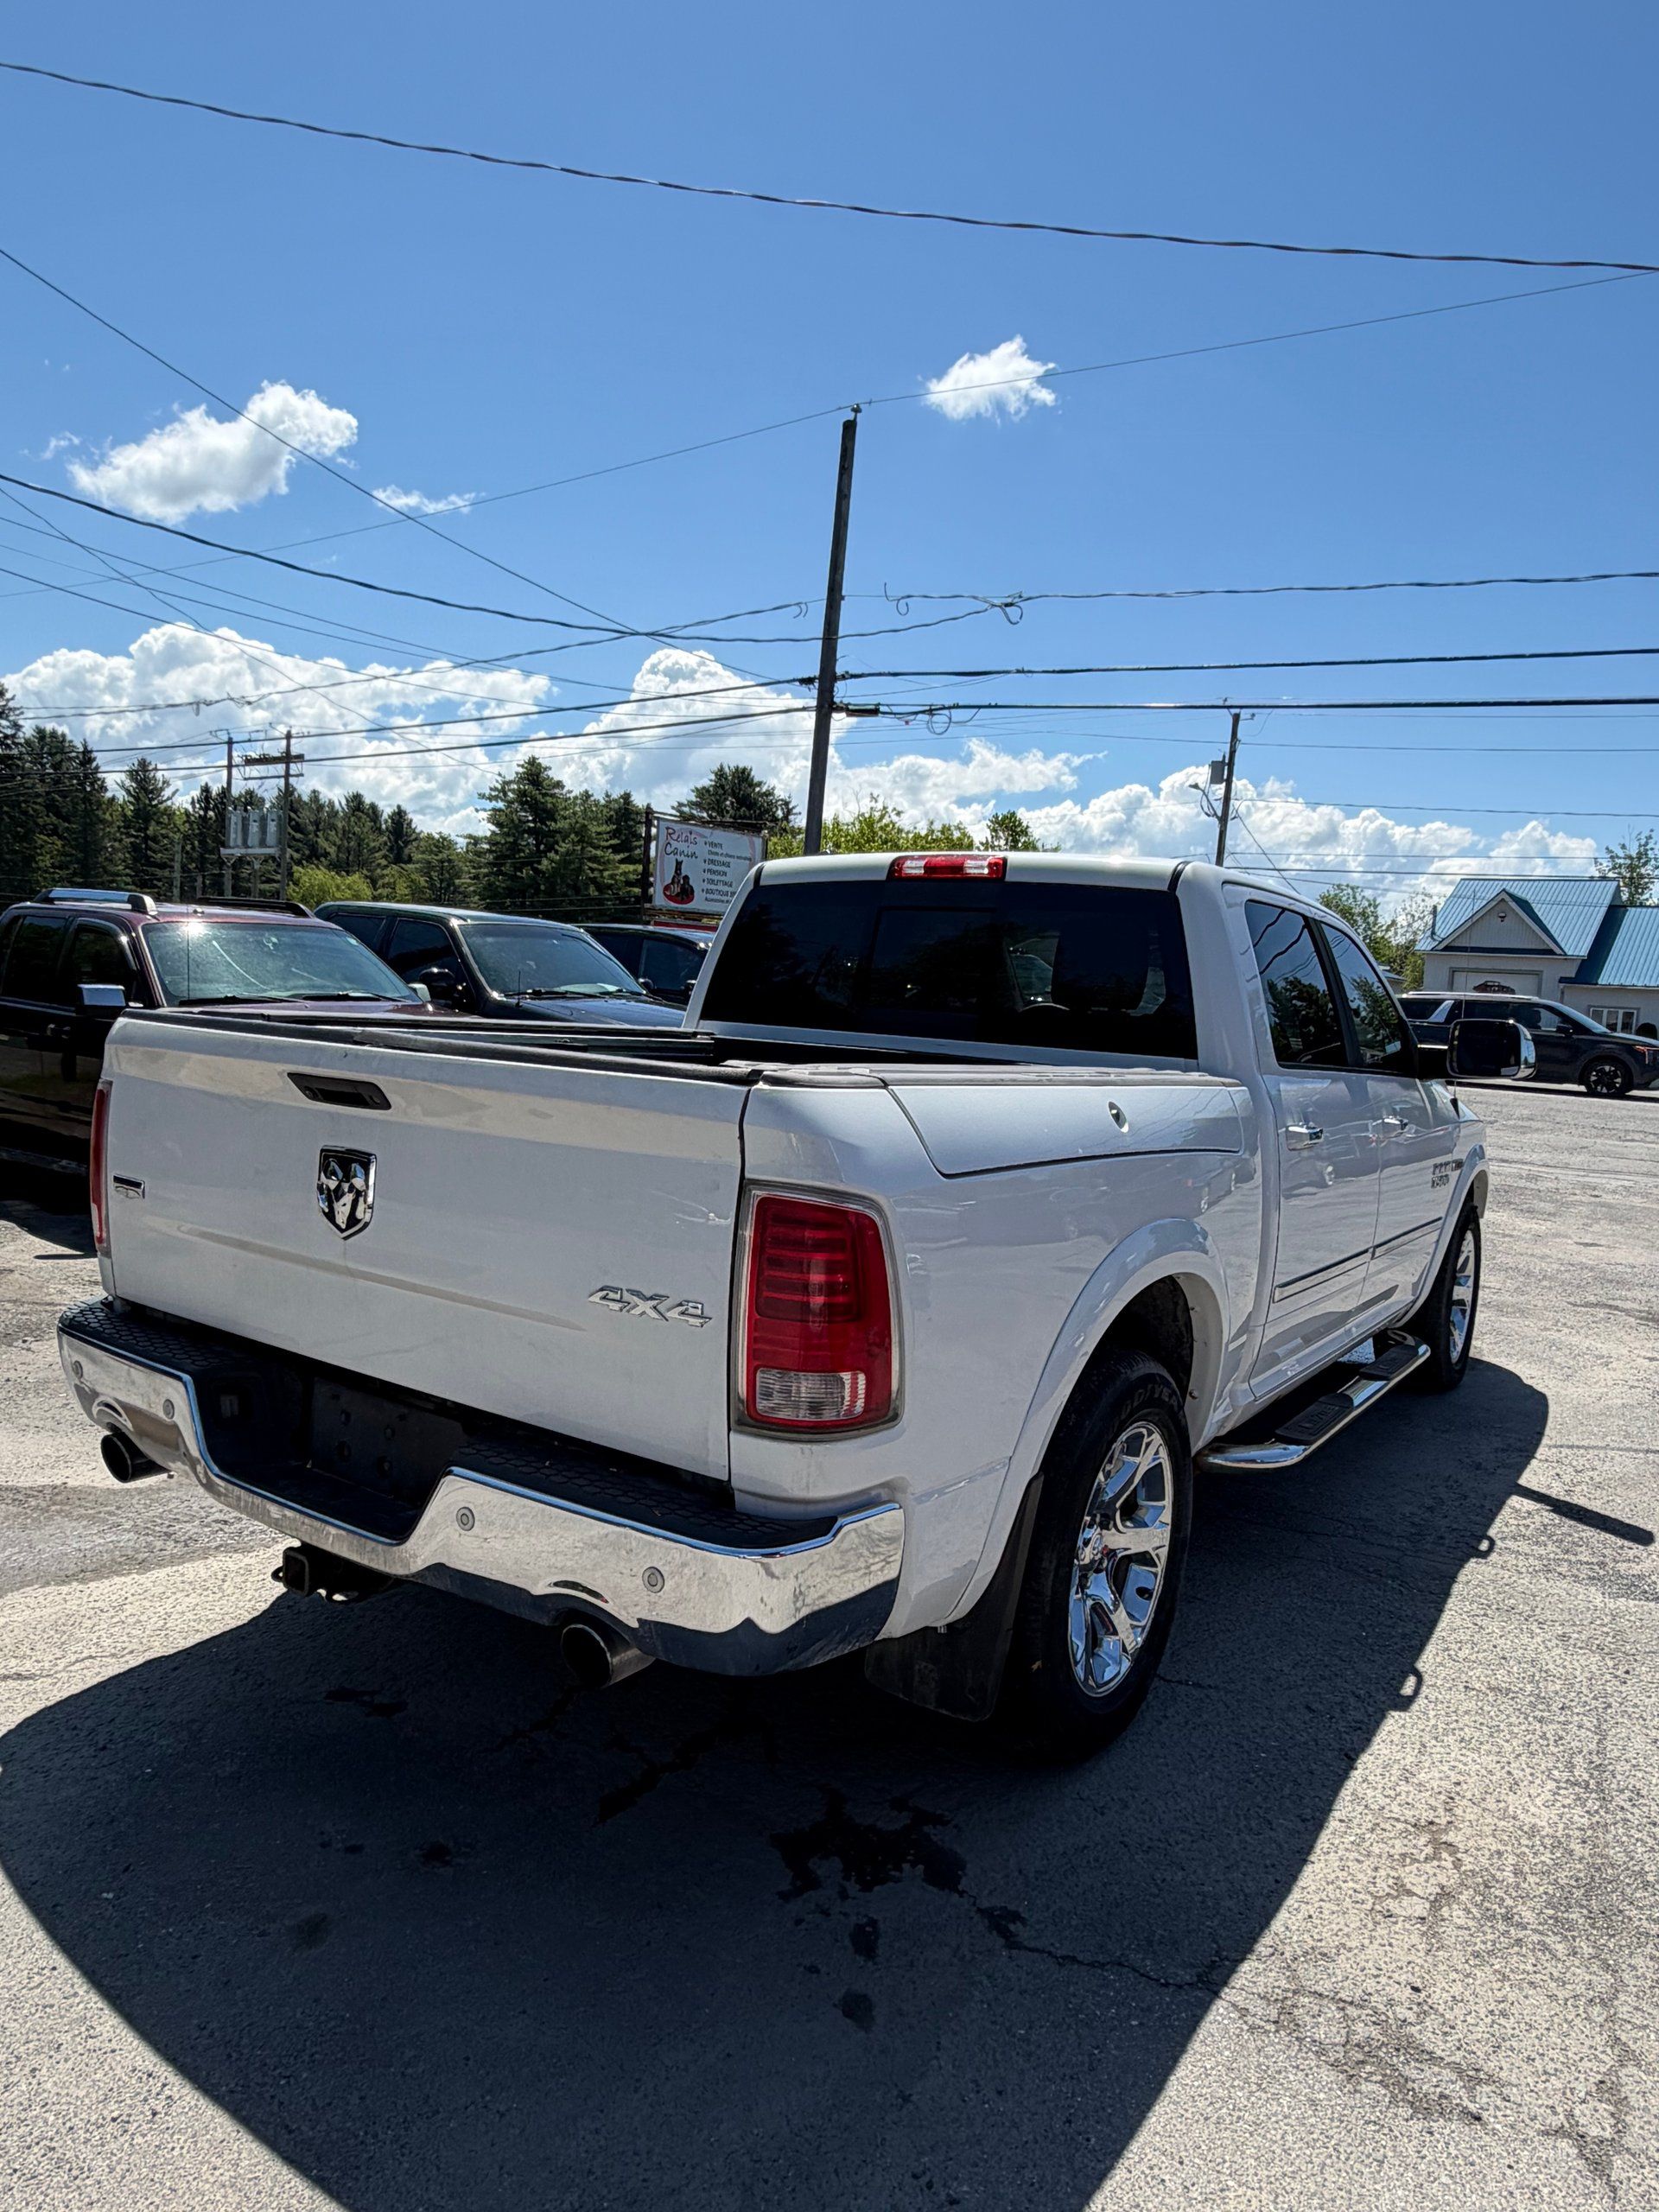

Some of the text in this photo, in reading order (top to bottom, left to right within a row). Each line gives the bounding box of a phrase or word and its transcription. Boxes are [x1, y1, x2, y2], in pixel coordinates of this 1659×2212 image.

[664, 826, 698, 845] Relais
[664, 842, 699, 859] Canin
[708, 840, 723, 850] VENTE
[707, 868, 728, 877] PENSION
